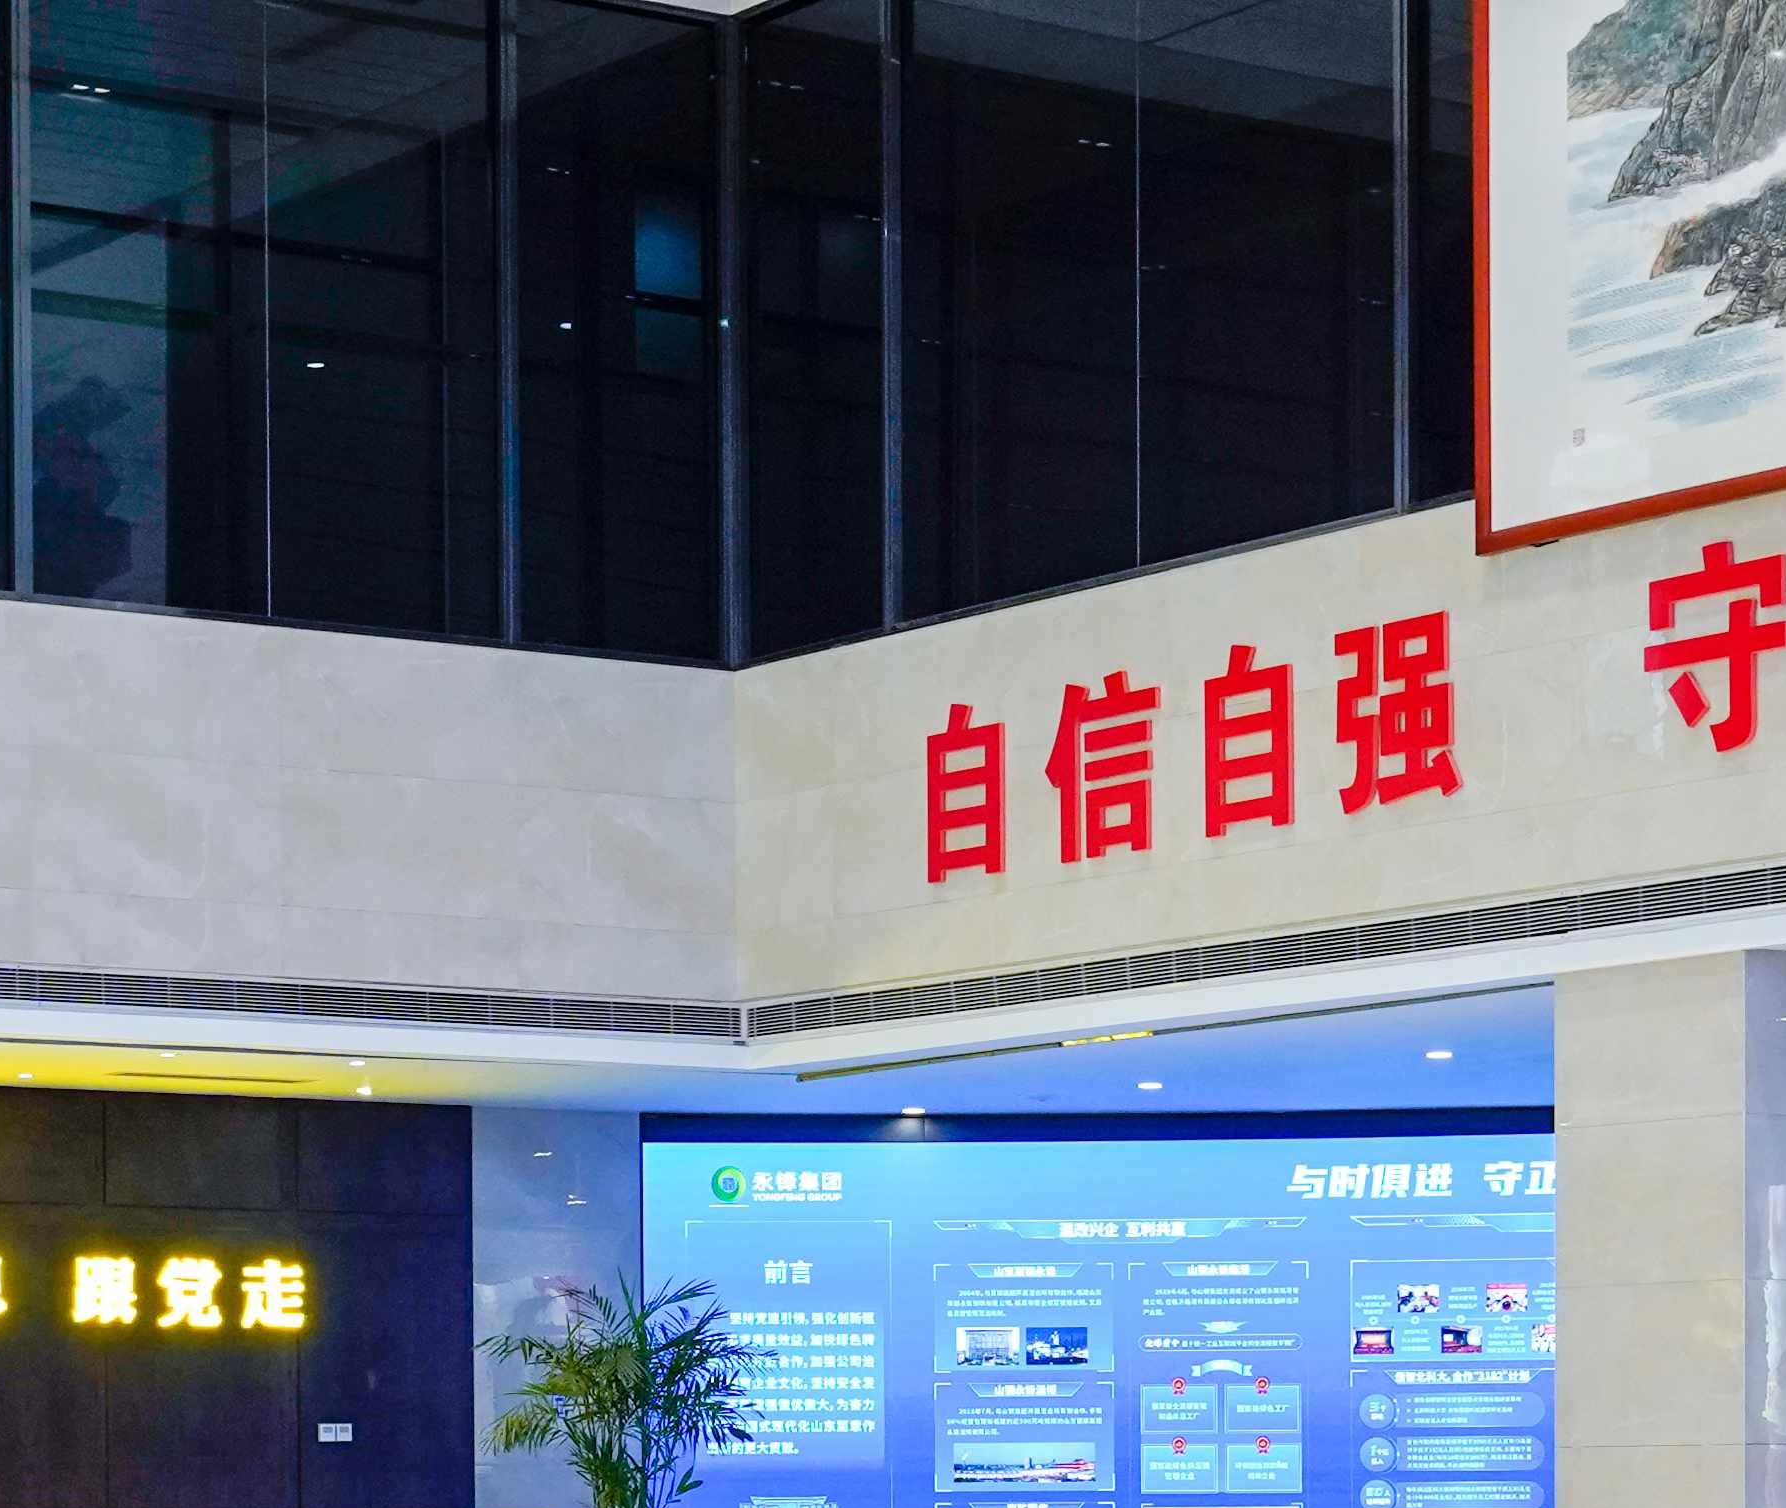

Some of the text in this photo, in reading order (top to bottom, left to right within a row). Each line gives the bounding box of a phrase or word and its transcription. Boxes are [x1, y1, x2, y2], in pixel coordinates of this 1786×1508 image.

[927, 612, 1458, 882] 自信自强
[752, 1172, 843, 1191] 永锋集团
[1285, 1161, 1556, 1199] 与时俱进 守正
[764, 1260, 813, 1284] 前言
[71, 1255, 307, 1331] 跟党走
